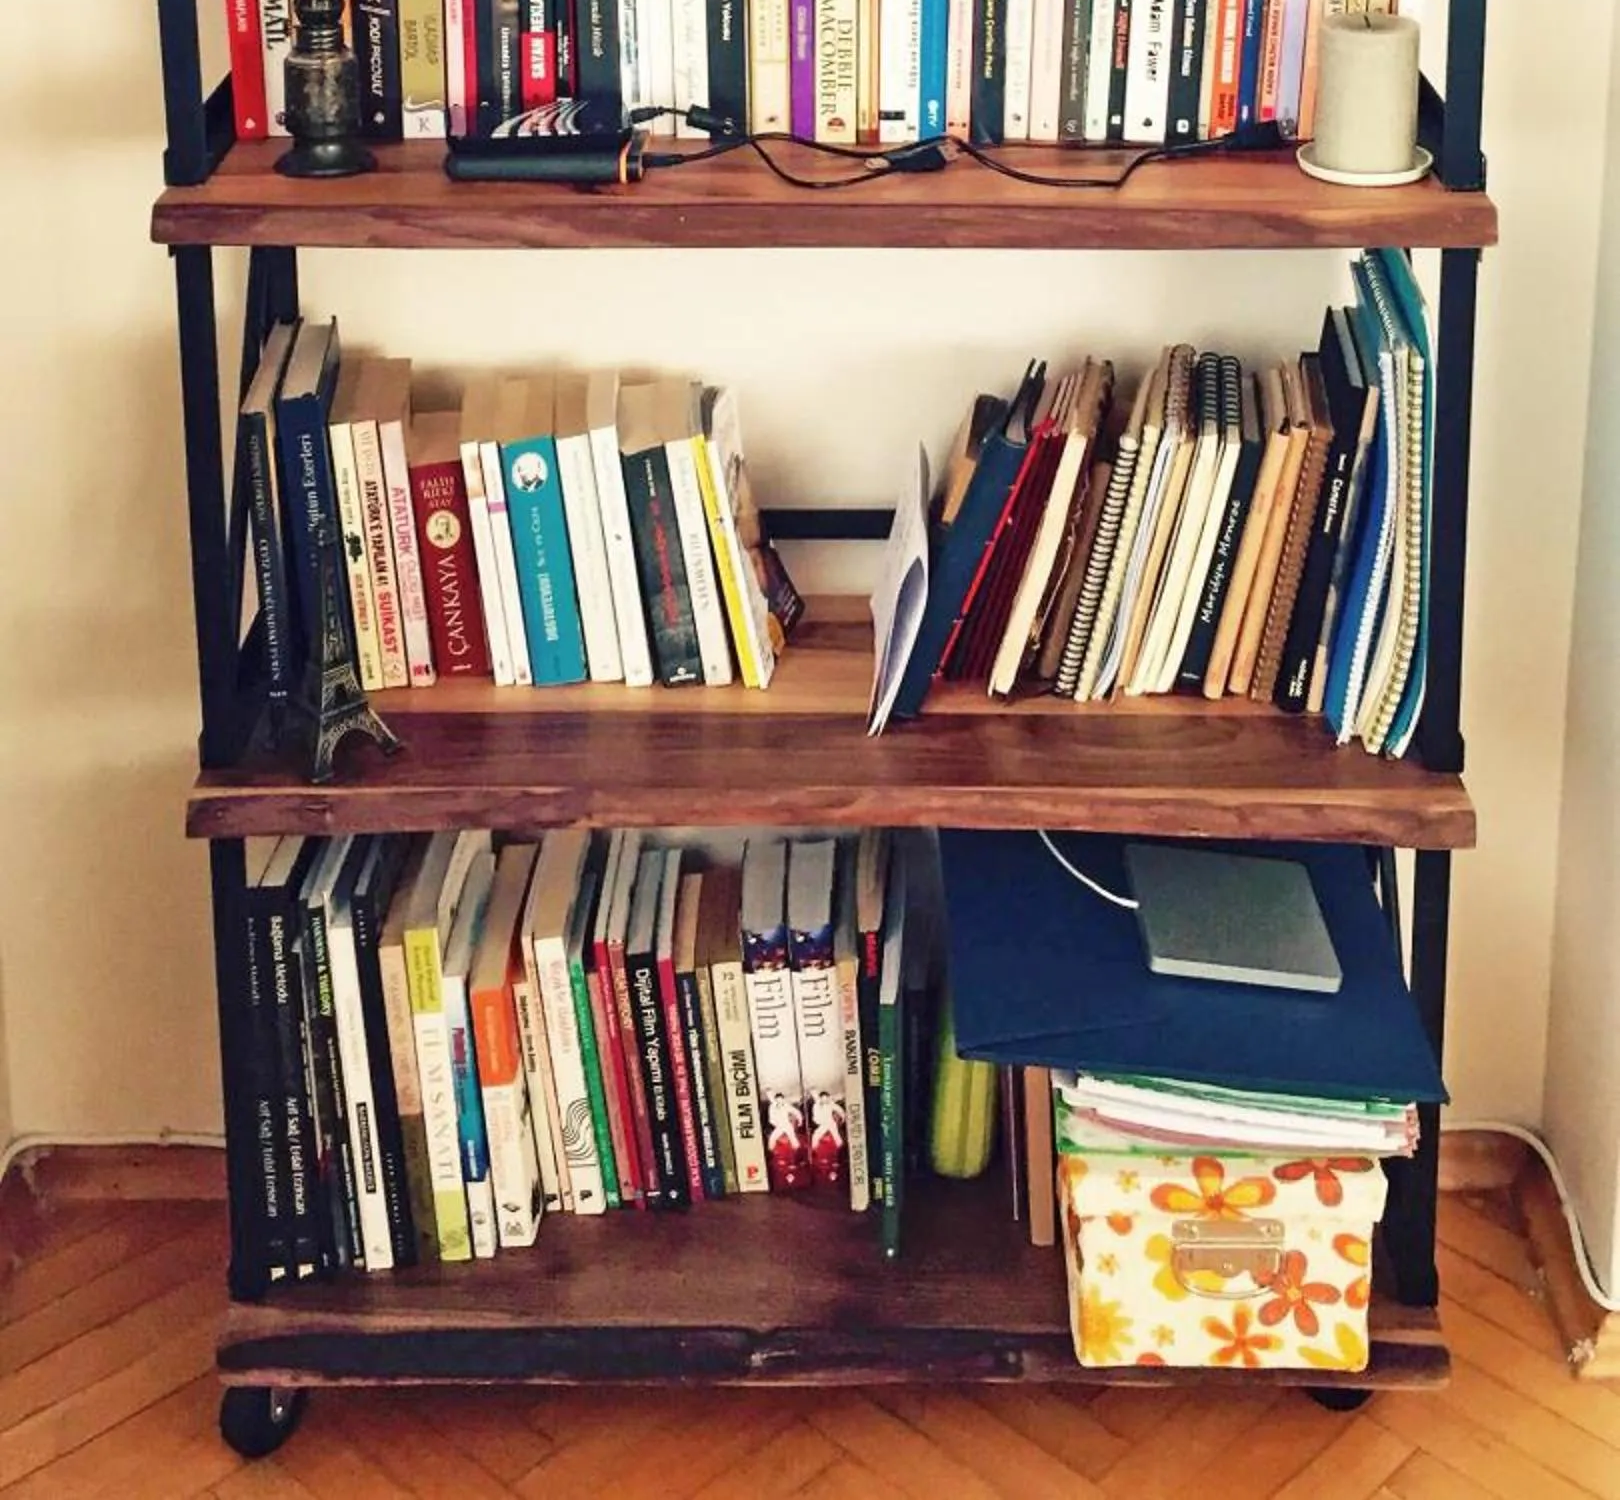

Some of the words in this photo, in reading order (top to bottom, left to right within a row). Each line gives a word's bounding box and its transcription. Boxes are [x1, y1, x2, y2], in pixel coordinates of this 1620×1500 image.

[837, 19, 853, 91] DEBBIE
[1145, 40, 1163, 82] Fawer
[298, 434, 317, 489] Eserleri
[391, 486, 414, 556] ATATÜRK
[371, 534, 387, 574] YAPILAN
[1200, 562, 1226, 624] Marilyn
[1217, 500, 1241, 557] Monroe
[378, 591, 399, 654] SUİKAST
[437, 554, 472, 656] ÇANKAYA
[270, 915, 284, 961] Bağlama
[275, 963, 288, 1004] Metodu
[318, 973, 333, 1017] THEORY
[800, 975, 833, 1038] Film
[643, 1008, 659, 1037] Film
[752, 977, 784, 1039] Film
[644, 1038, 664, 1083] Yapımı
[728, 1049, 750, 1097] BİÇİMİ
[734, 1103, 755, 1139] FİLM
